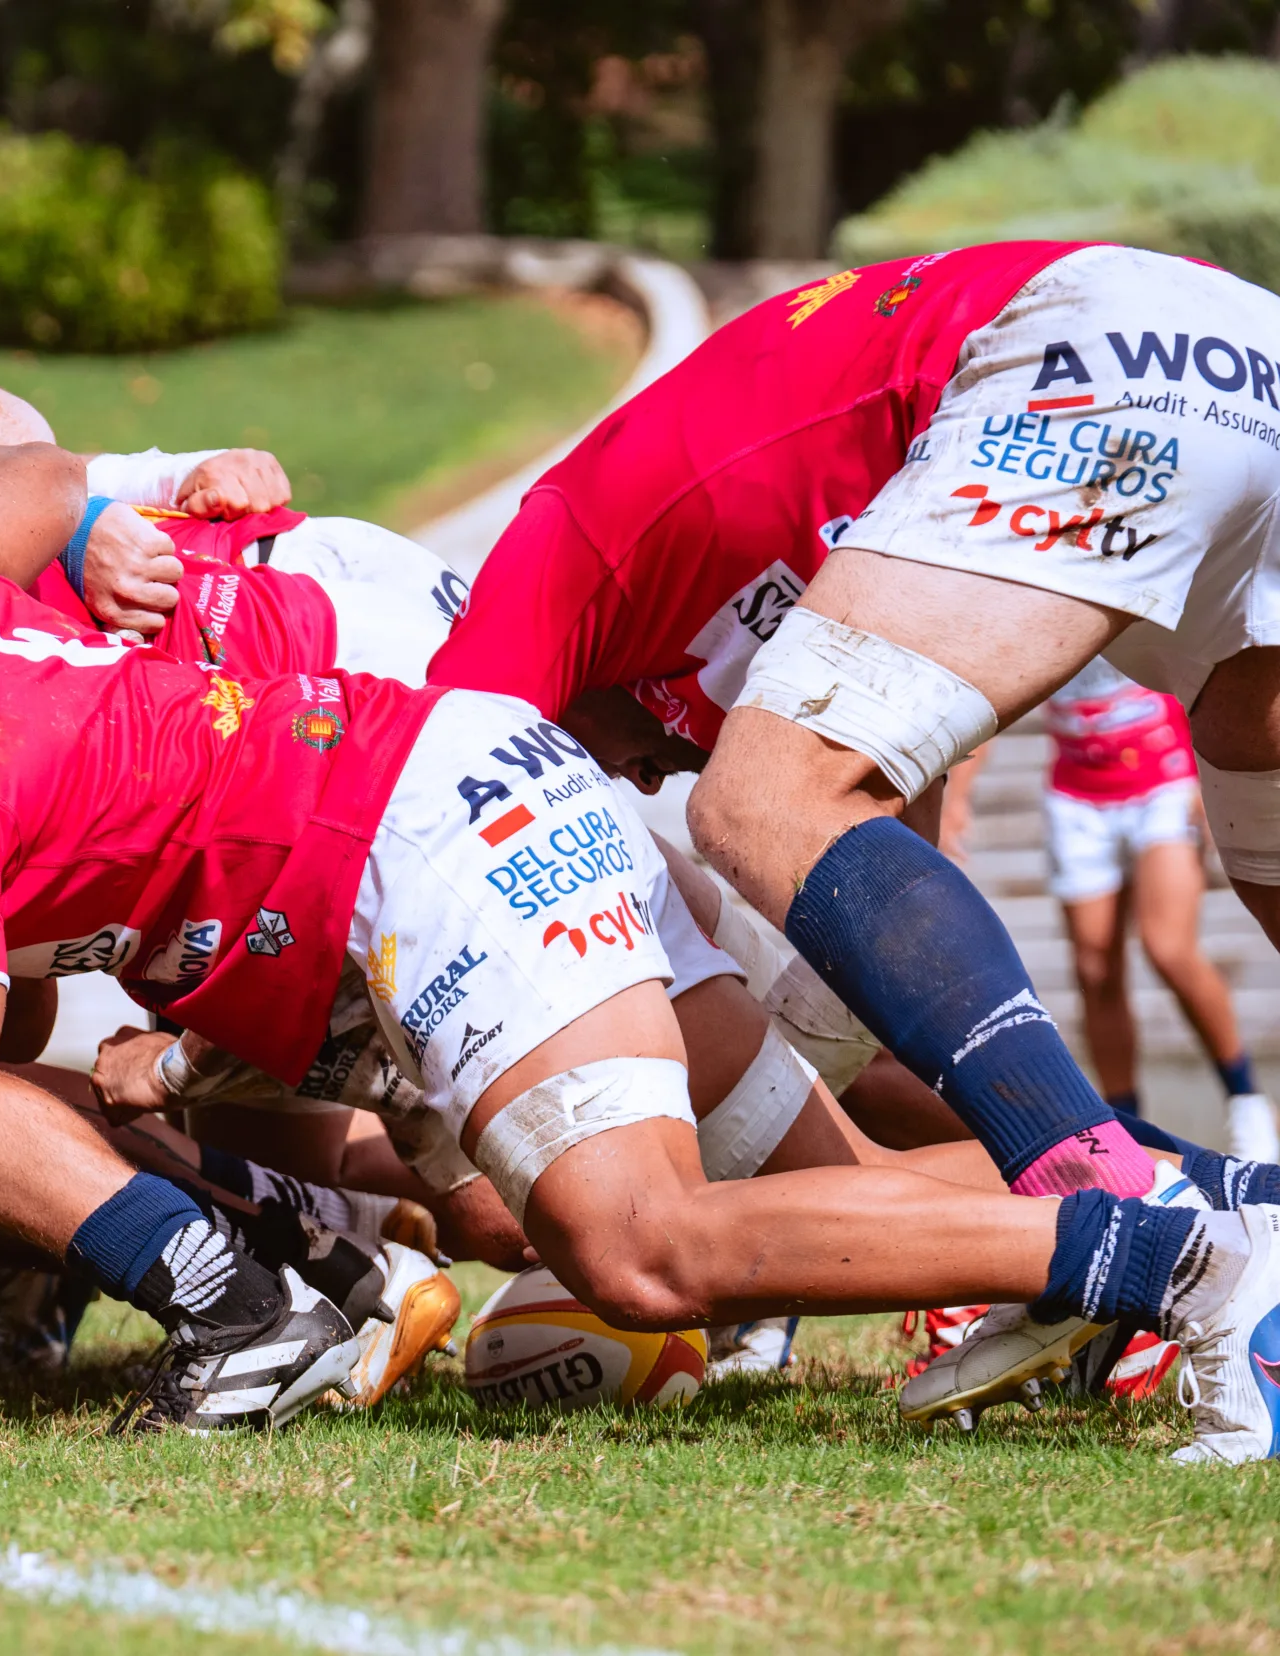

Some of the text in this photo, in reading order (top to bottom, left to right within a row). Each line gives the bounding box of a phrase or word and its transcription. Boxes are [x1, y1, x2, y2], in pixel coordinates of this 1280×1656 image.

[1030, 331, 1280, 412] A WOR
[982, 412, 1180, 471] DEL CURA
[1114, 391, 1280, 451] Audit Assuranc
[970, 439, 1174, 503] SEGUROS
[456, 722, 588, 826] A WO
[541, 773, 593, 808] Audit
[484, 806, 623, 897] DEL CURA
[508, 838, 635, 921] SEGUROS
[400, 944, 489, 1036] RURAL
[450, 1020, 504, 1083] MERCURY
